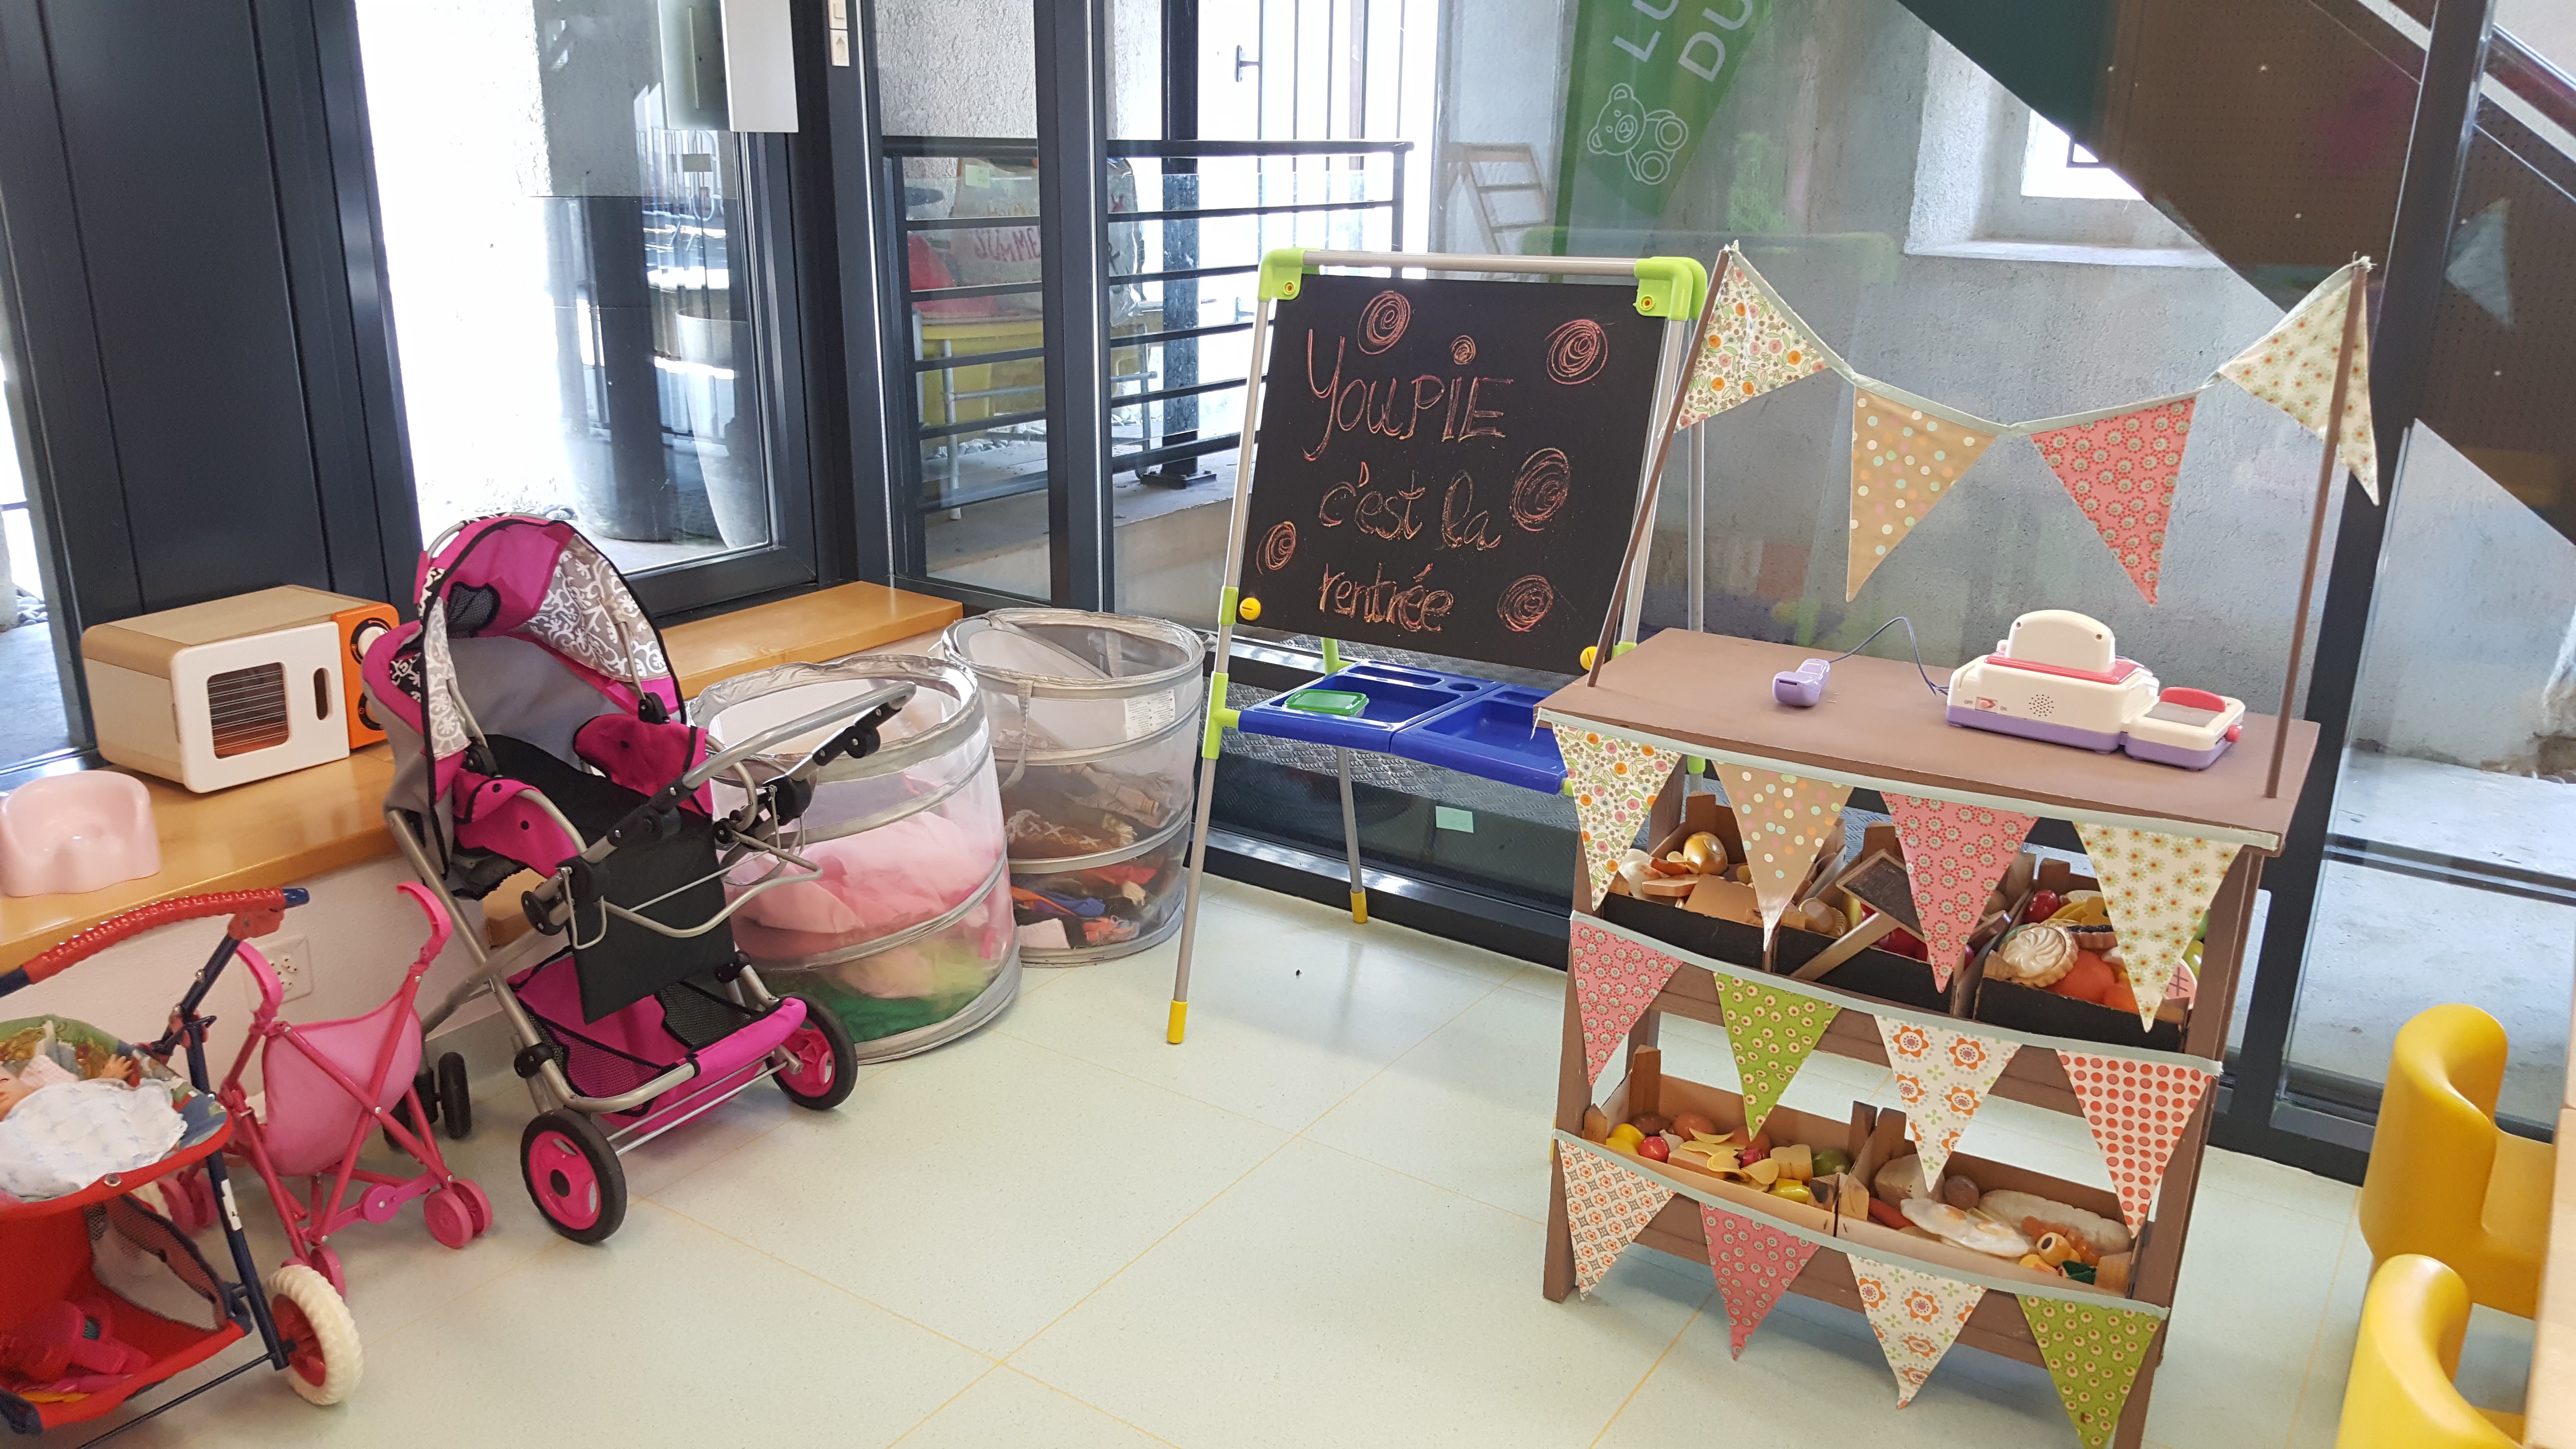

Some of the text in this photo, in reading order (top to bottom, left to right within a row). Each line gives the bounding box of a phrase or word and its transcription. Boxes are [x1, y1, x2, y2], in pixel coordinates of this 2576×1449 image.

[1319, 461, 1502, 551] c'est la
[1318, 562, 1454, 632] rentrée
